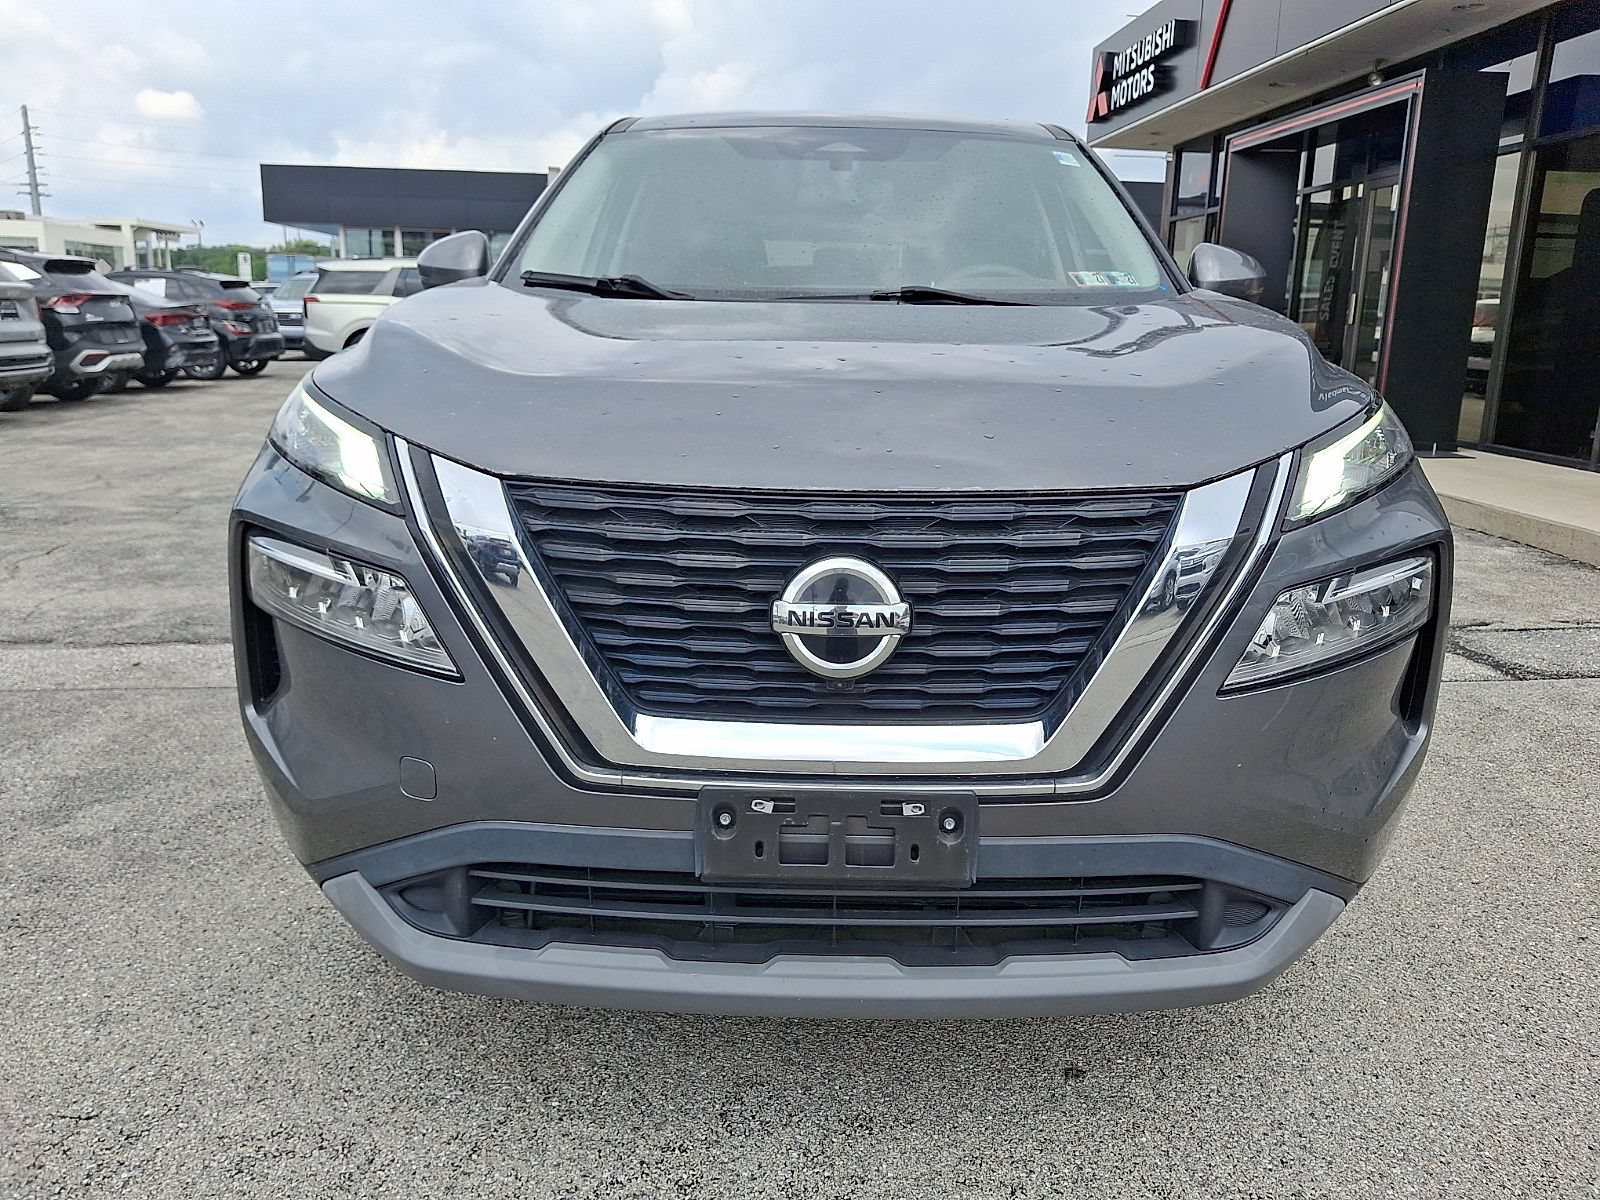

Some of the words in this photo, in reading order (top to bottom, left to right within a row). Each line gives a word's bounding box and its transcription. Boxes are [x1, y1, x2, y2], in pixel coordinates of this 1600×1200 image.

[1112, 19, 1176, 80] MITSUBISHI
[1111, 64, 1155, 110] MOTORS
[787, 610, 895, 628] NISSAN
